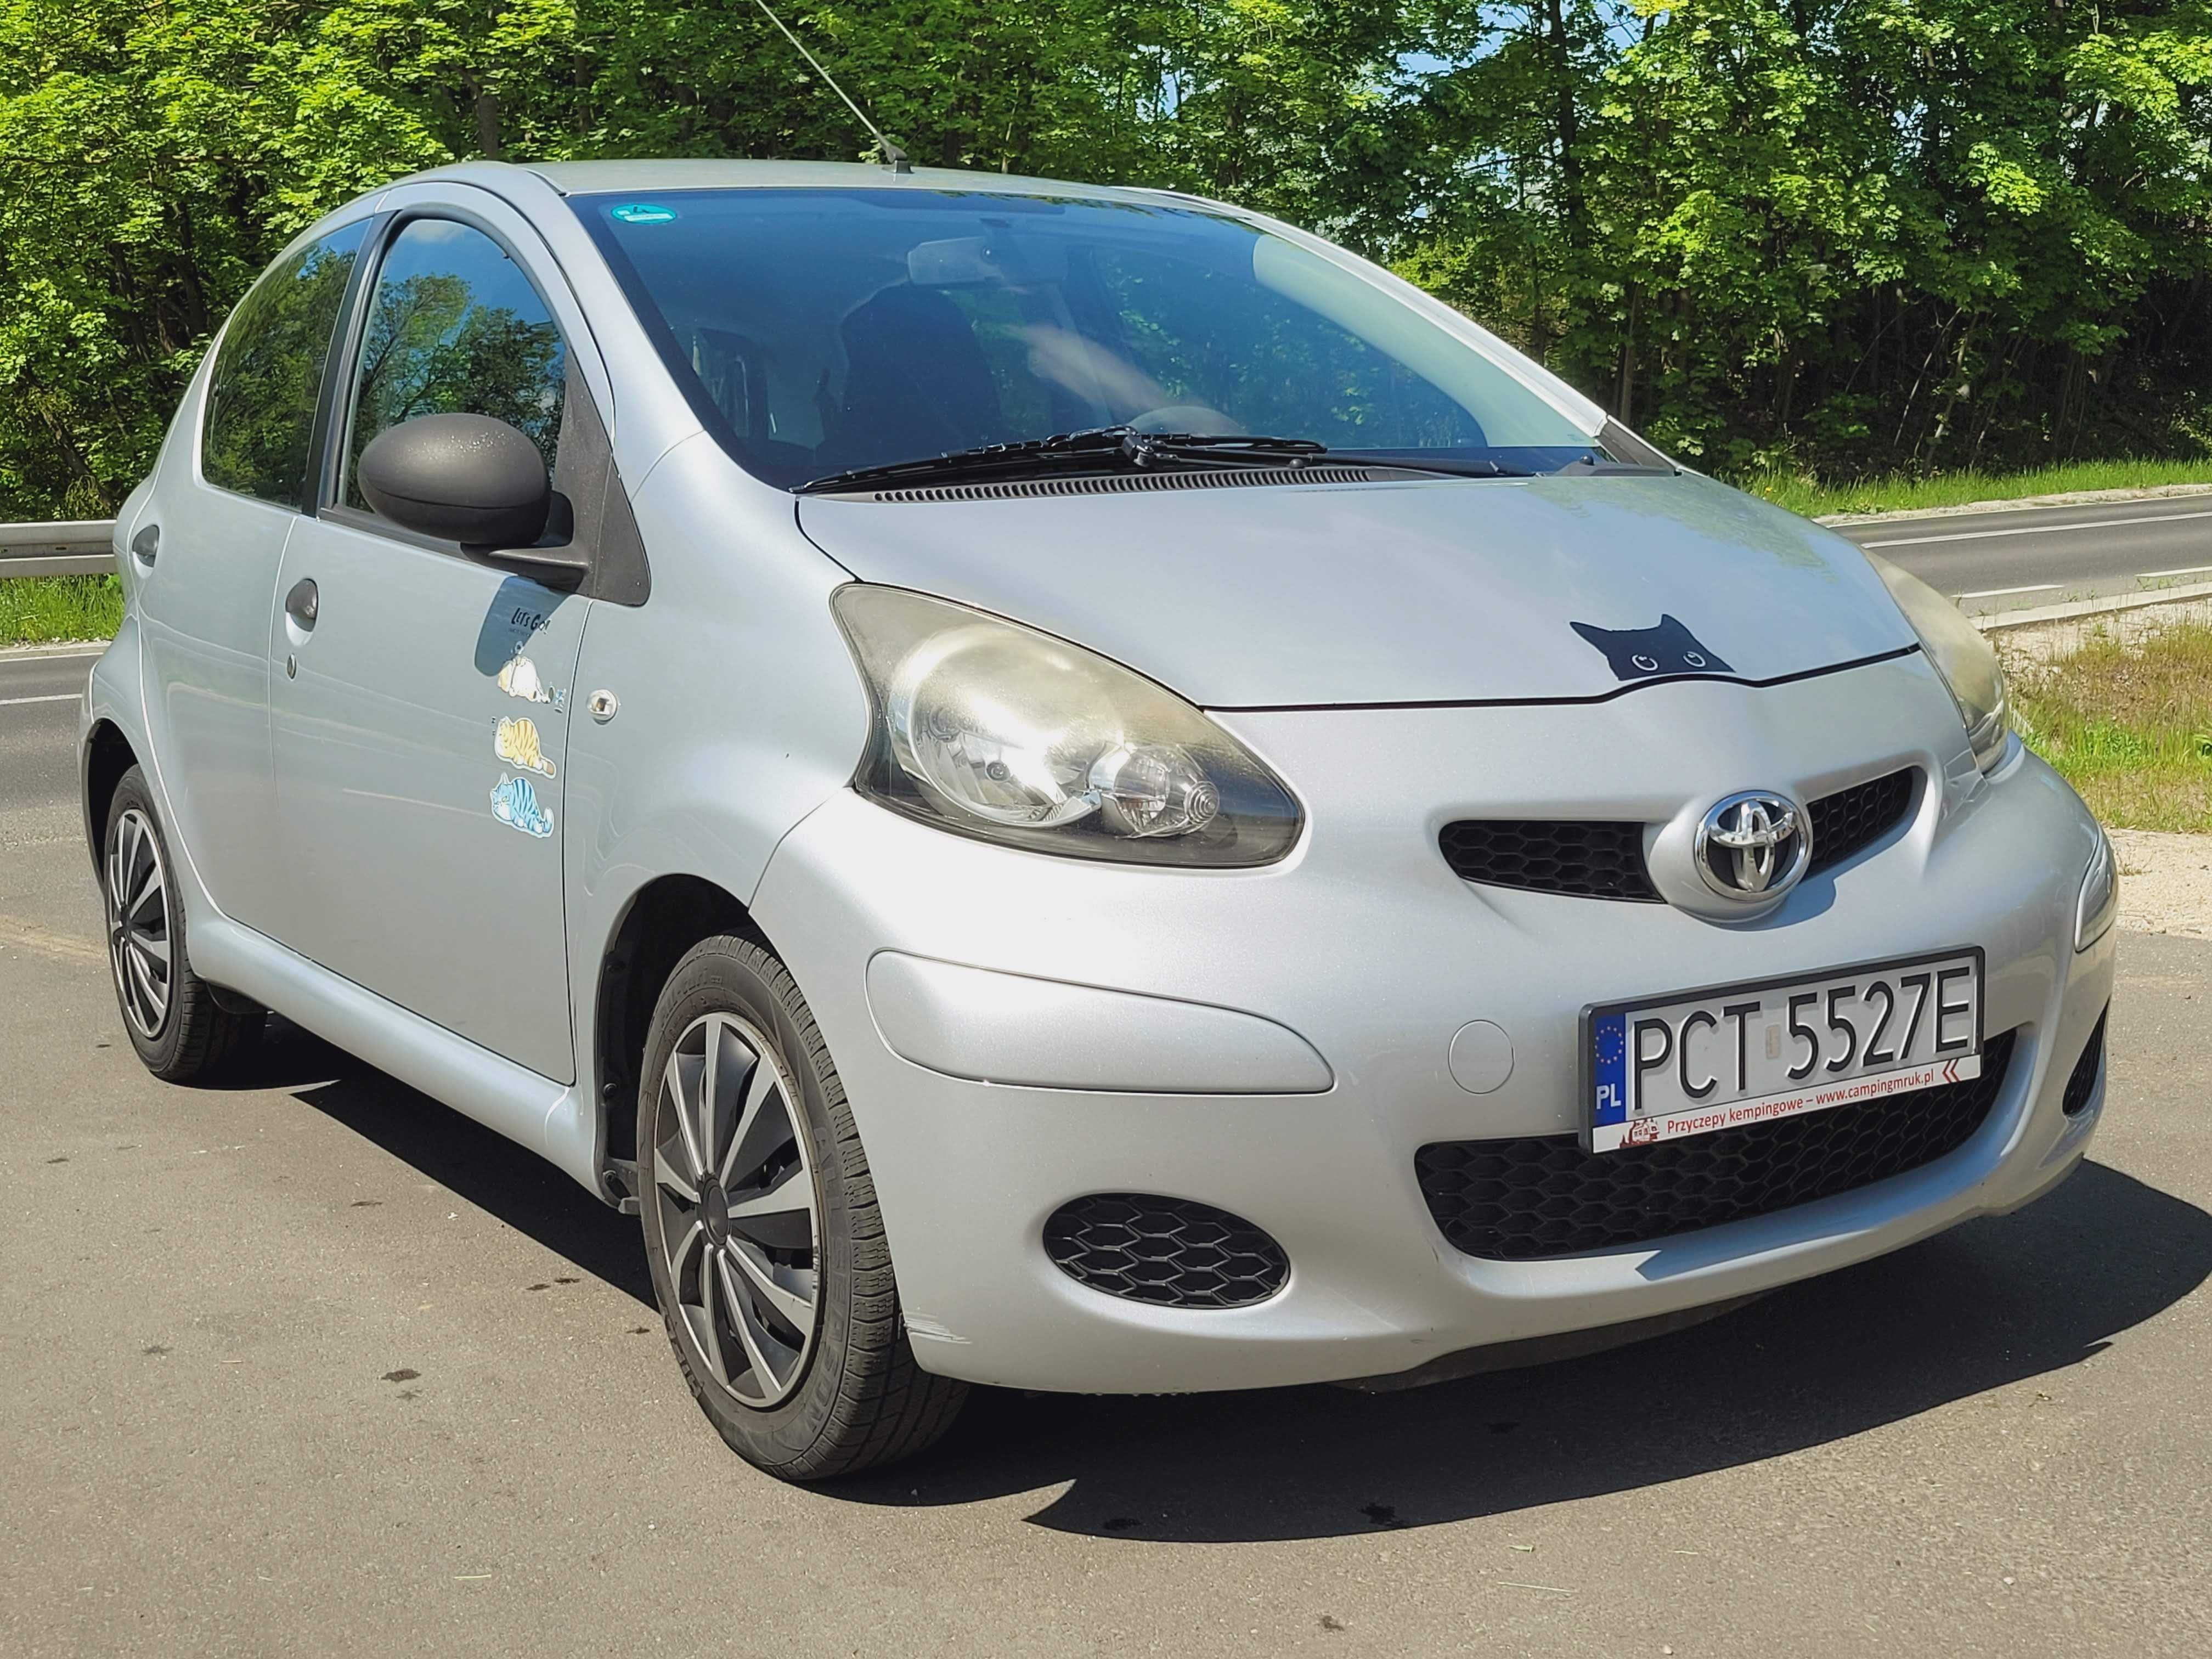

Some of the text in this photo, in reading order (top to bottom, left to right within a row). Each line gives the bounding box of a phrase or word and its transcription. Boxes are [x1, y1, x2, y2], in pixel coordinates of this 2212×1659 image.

[1633, 966, 1970, 1110] PCT 5527E
[1596, 1083, 1622, 1110] PL
[1667, 1113, 1726, 1134] Przyczepy
[1729, 1097, 1803, 1121] kempingowe
[1815, 1068, 1934, 1105] www.campingmruk.pl
